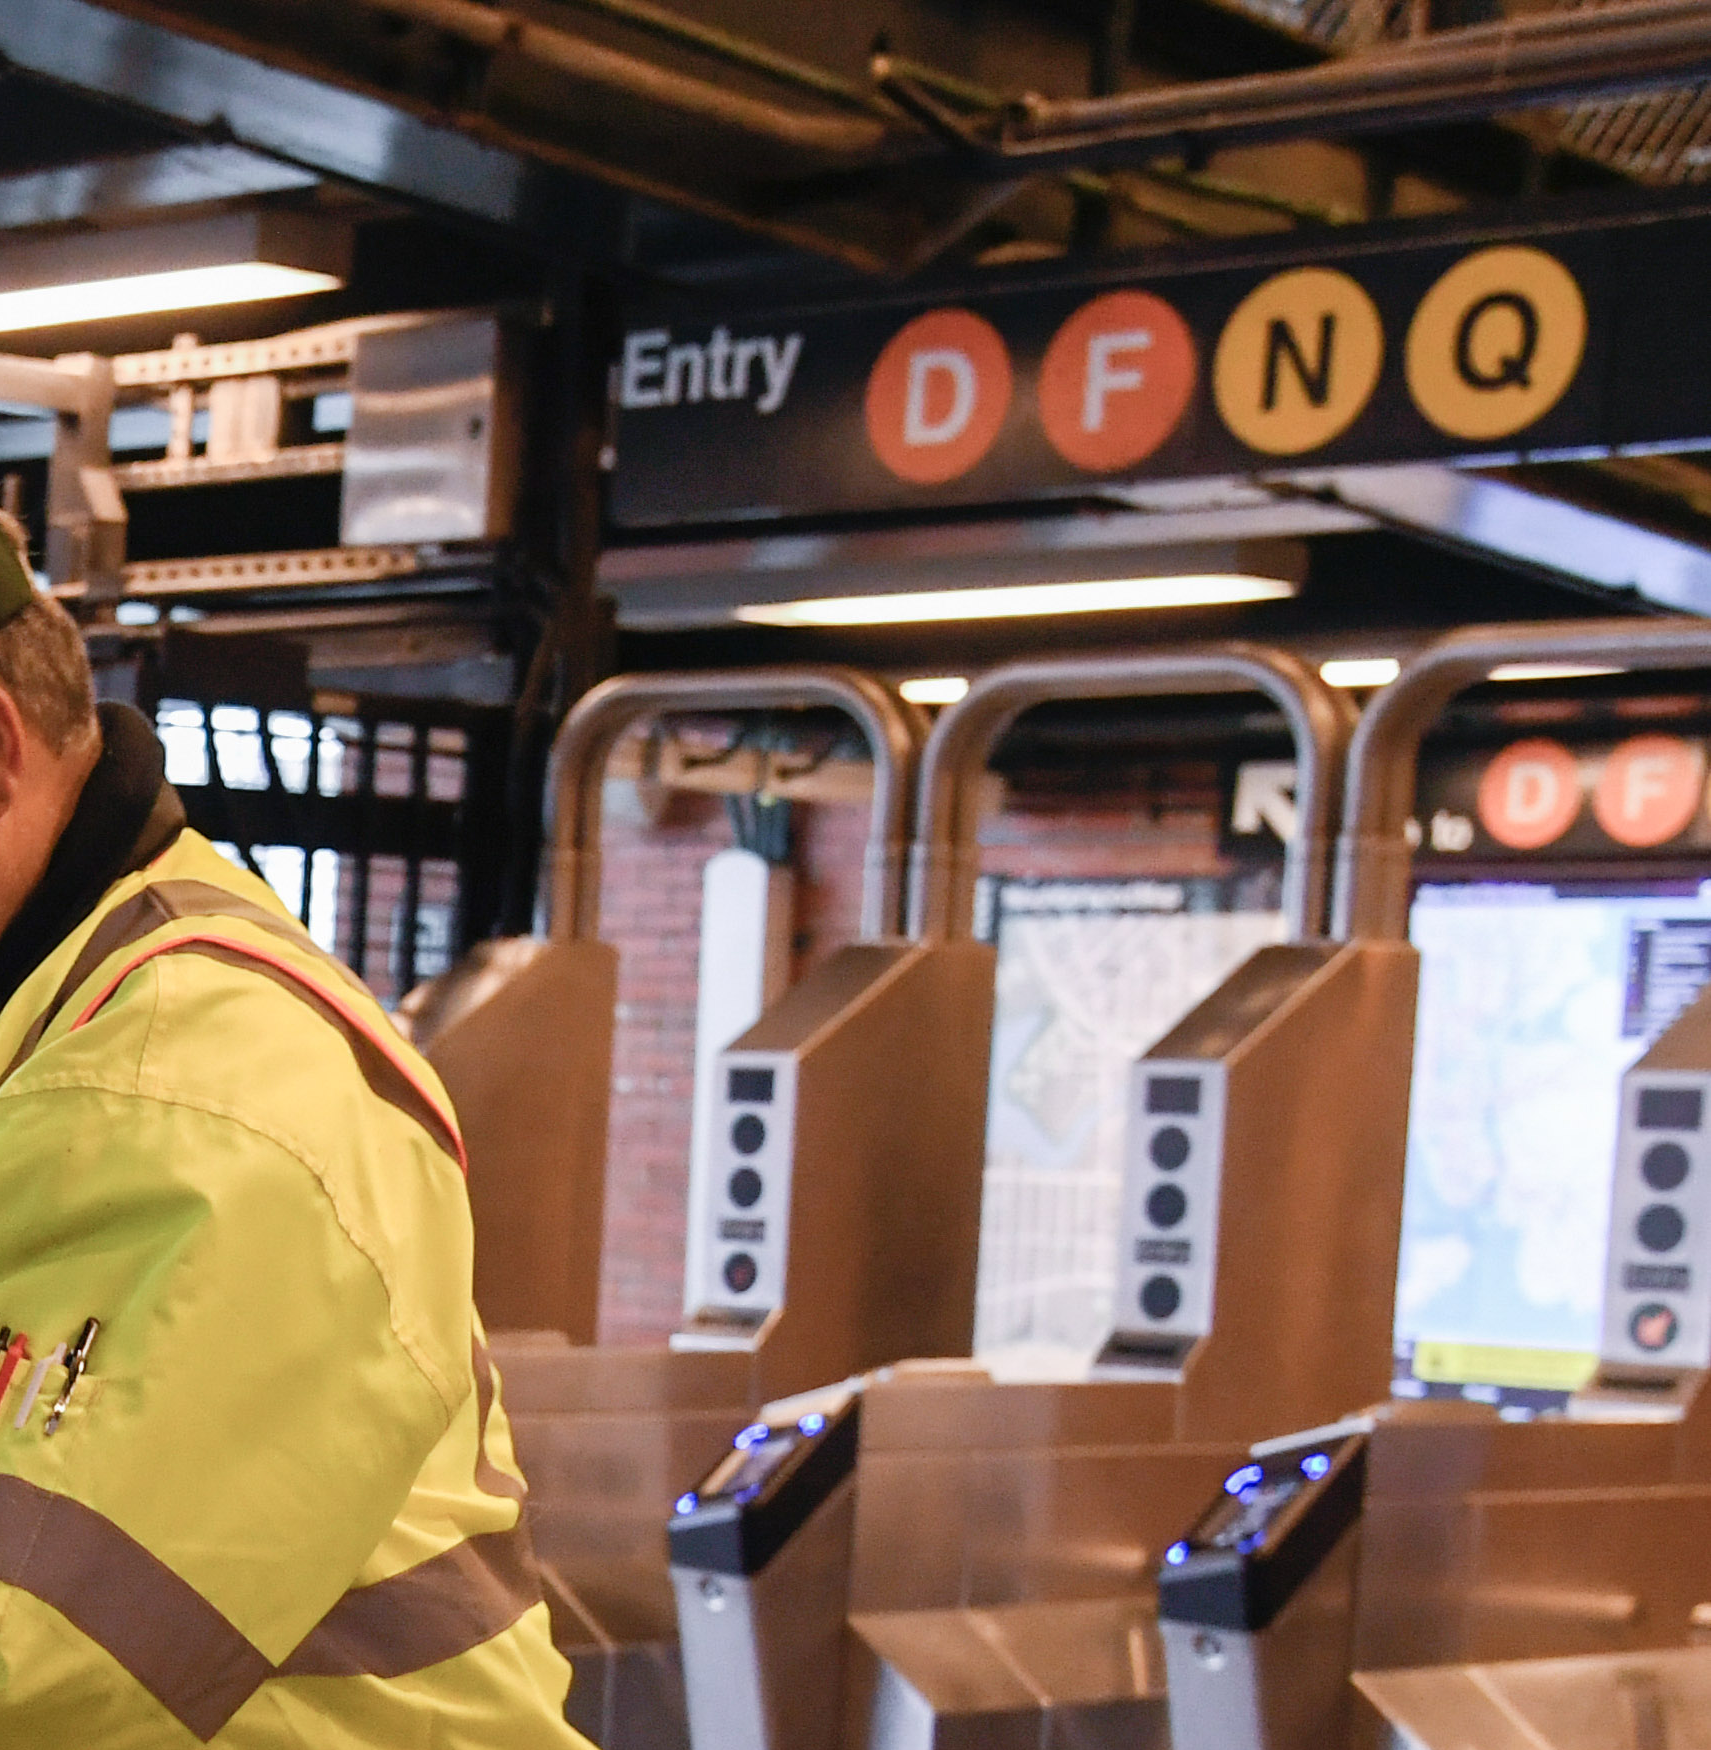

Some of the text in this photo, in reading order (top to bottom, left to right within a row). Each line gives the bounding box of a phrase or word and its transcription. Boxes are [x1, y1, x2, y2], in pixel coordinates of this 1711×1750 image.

[621, 291, 1541, 447] Entry D F N Q
[1505, 761, 1559, 823] D
[1623, 756, 1672, 822] F
